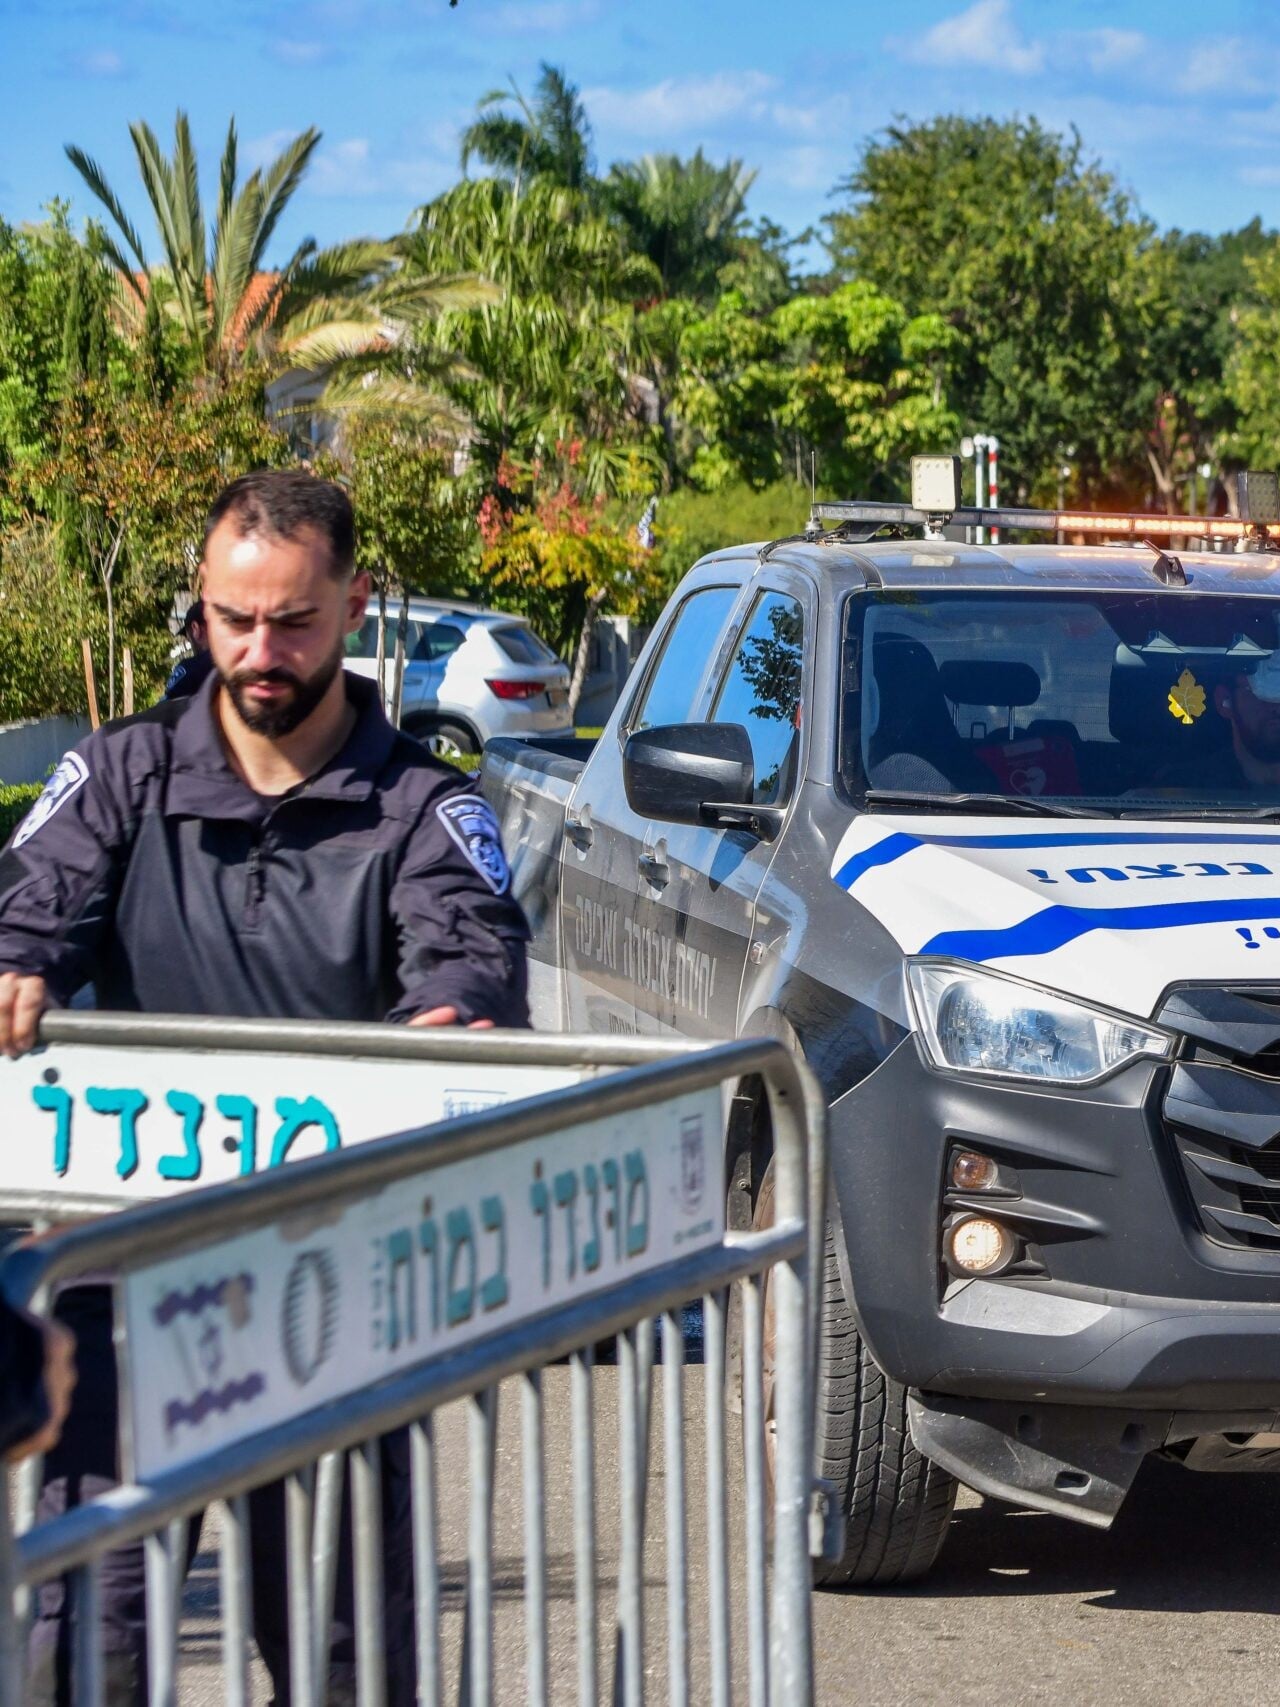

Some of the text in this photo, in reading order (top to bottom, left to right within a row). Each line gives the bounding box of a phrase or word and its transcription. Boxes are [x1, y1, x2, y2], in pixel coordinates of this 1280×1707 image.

[1027, 862, 1275, 884] ננצח!
[575, 894, 618, 971] ואכיפה
[674, 941, 718, 1020] יחידת
